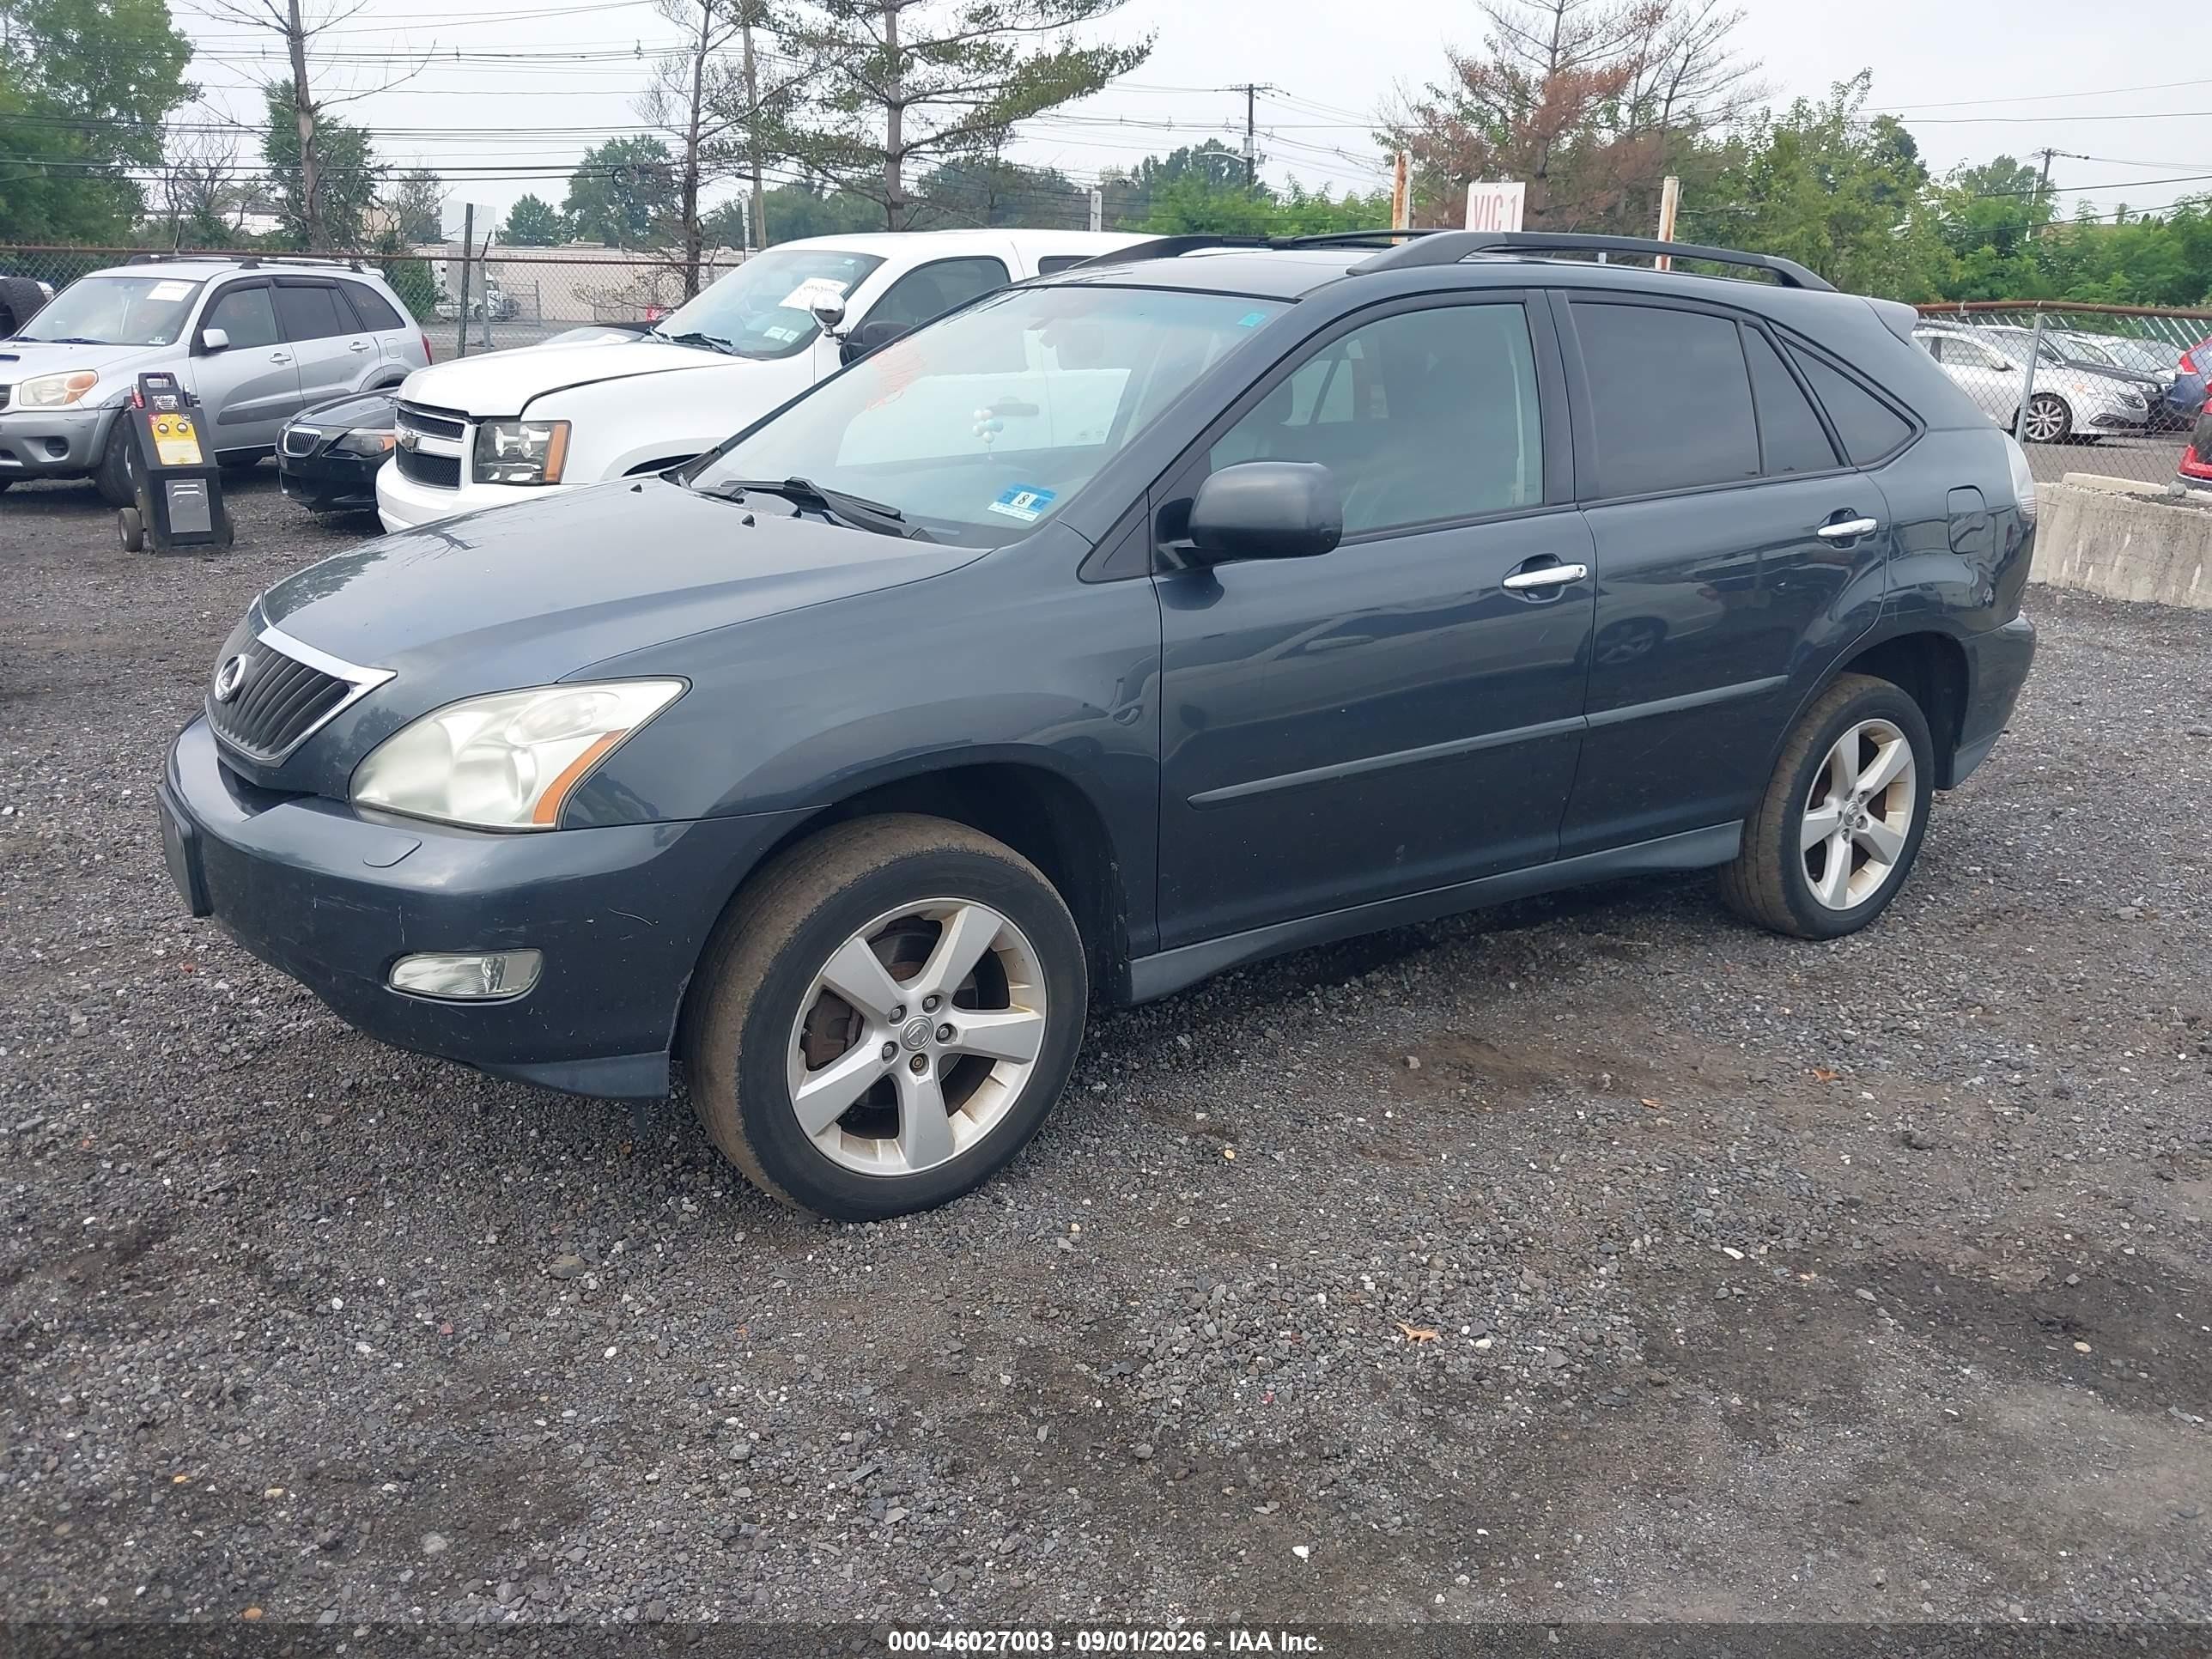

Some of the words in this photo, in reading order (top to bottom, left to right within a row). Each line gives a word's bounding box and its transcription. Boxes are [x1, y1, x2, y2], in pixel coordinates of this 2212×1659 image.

[1474, 194, 1504, 231] VIC
[1510, 194, 1517, 231] 1
[1018, 494, 1030, 505] 8
